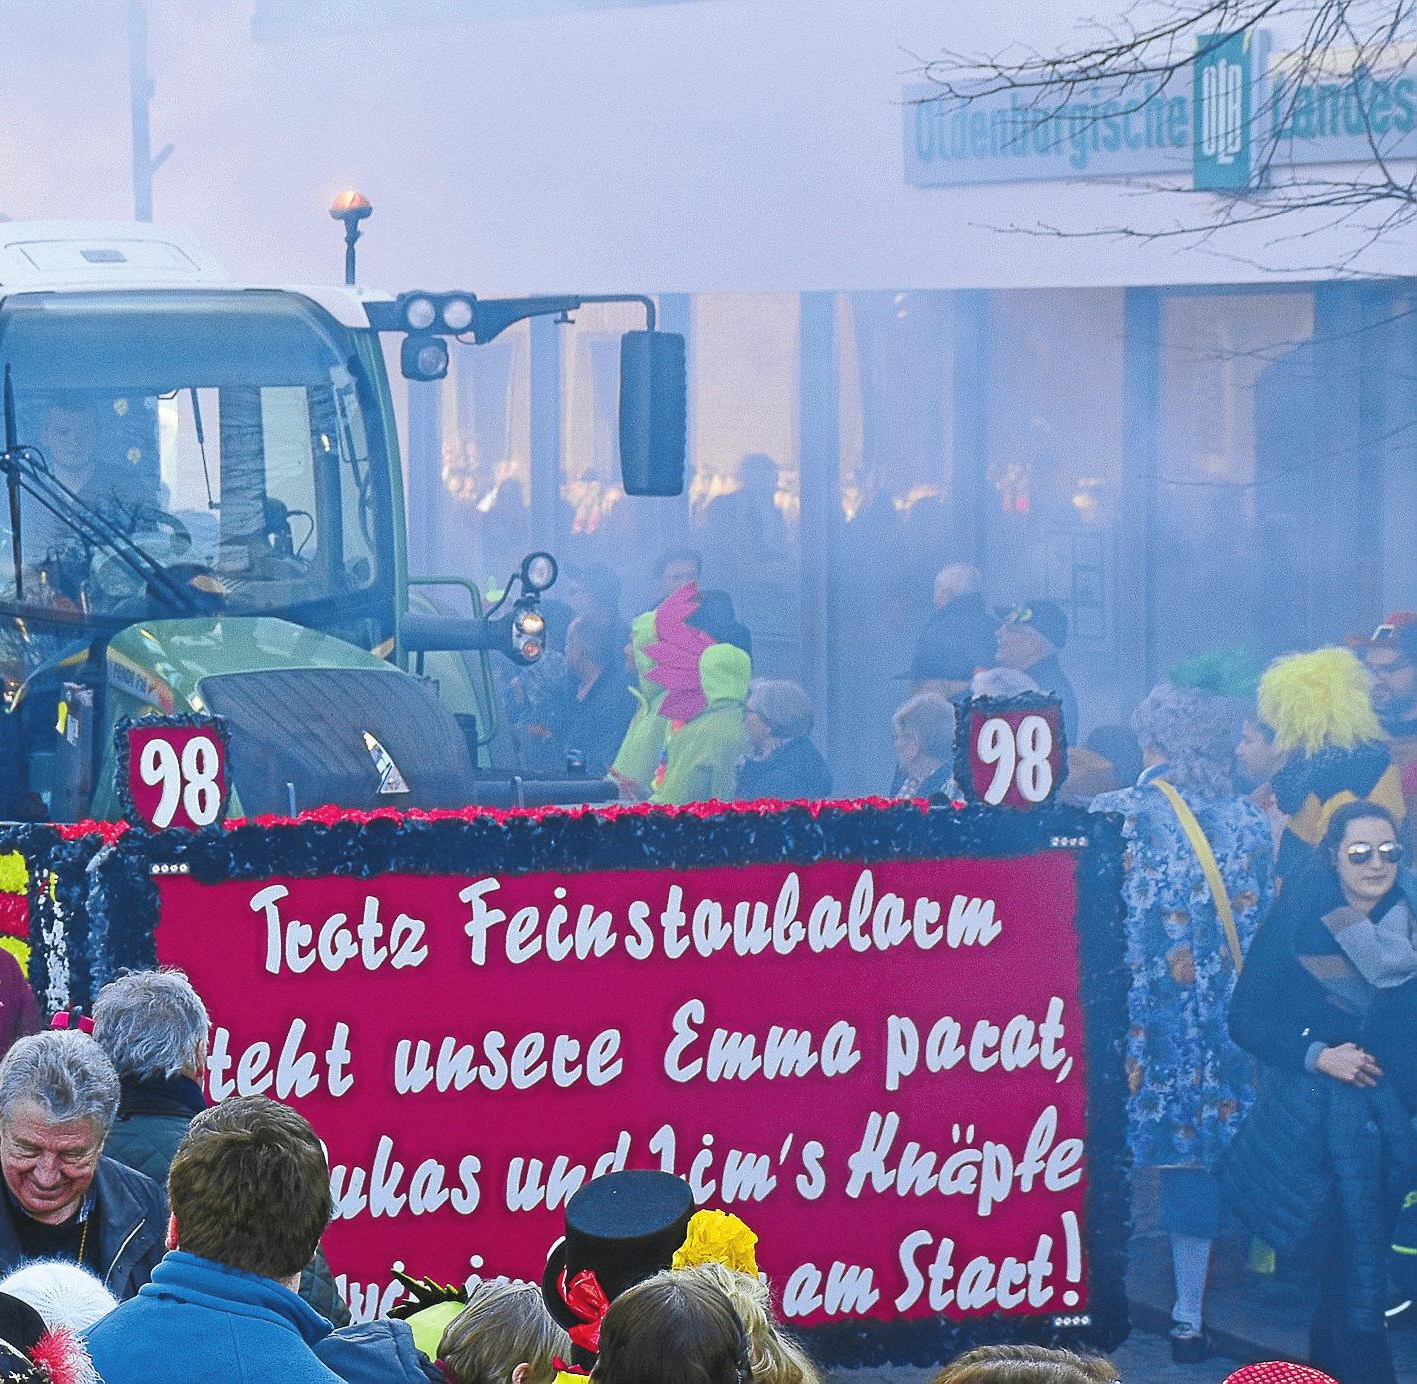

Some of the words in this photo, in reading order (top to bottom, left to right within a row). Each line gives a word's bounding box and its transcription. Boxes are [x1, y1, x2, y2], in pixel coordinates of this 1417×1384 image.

[139, 735, 221, 829] 98
[977, 715, 1053, 806] 98
[249, 883, 429, 976] Trotz
[458, 868, 1003, 967] Feinstaubalarm
[202, 1017, 355, 1103] teht
[394, 1028, 624, 1096] unsere
[663, 998, 861, 1084] Emma
[885, 995, 1074, 1092] parat,
[319, 1134, 482, 1222] ukas
[782, 1259, 881, 1319] am
[894, 1209, 1082, 1313] Start!
